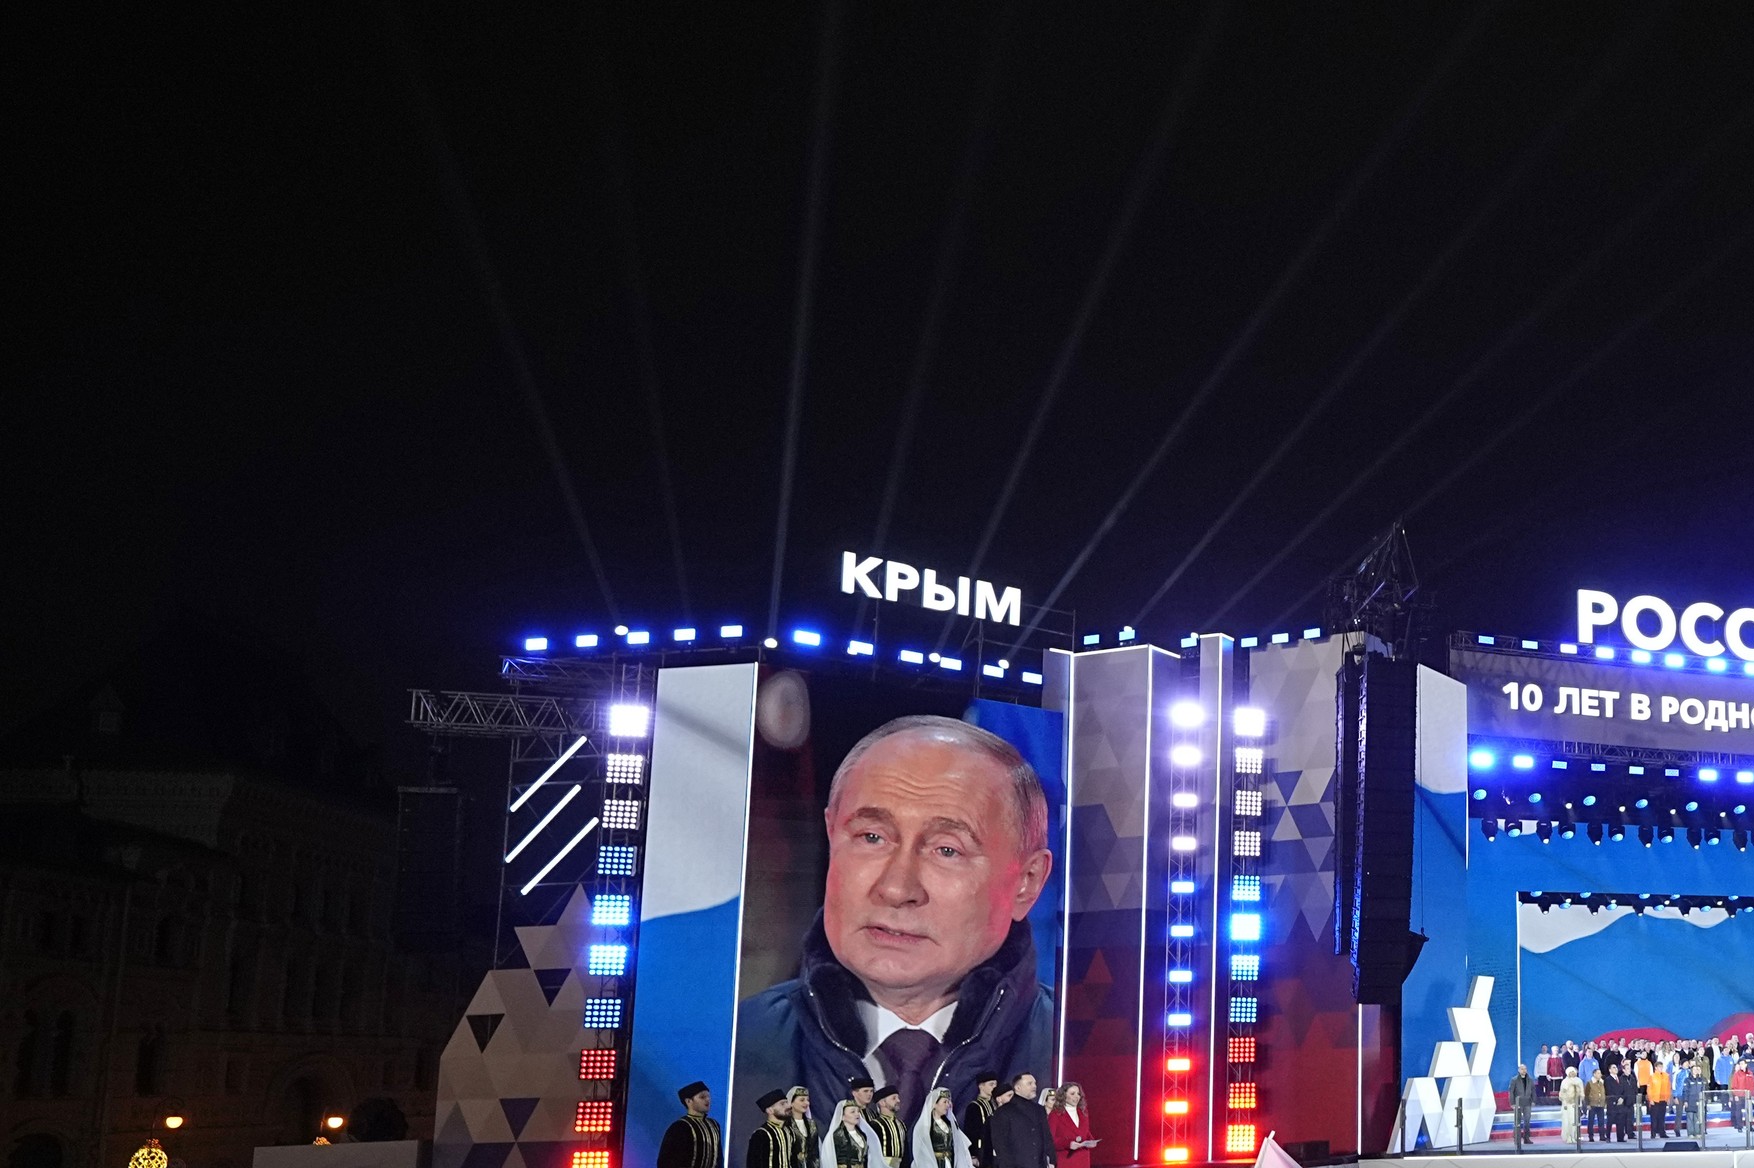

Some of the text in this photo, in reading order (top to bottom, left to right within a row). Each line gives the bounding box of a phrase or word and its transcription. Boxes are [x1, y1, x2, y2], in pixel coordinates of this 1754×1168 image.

[841, 551, 1022, 627] КРЫМ
[1502, 681, 1543, 712] 10
[1554, 686, 1620, 719] ЛЕТ
[1630, 694, 1652, 722] В
